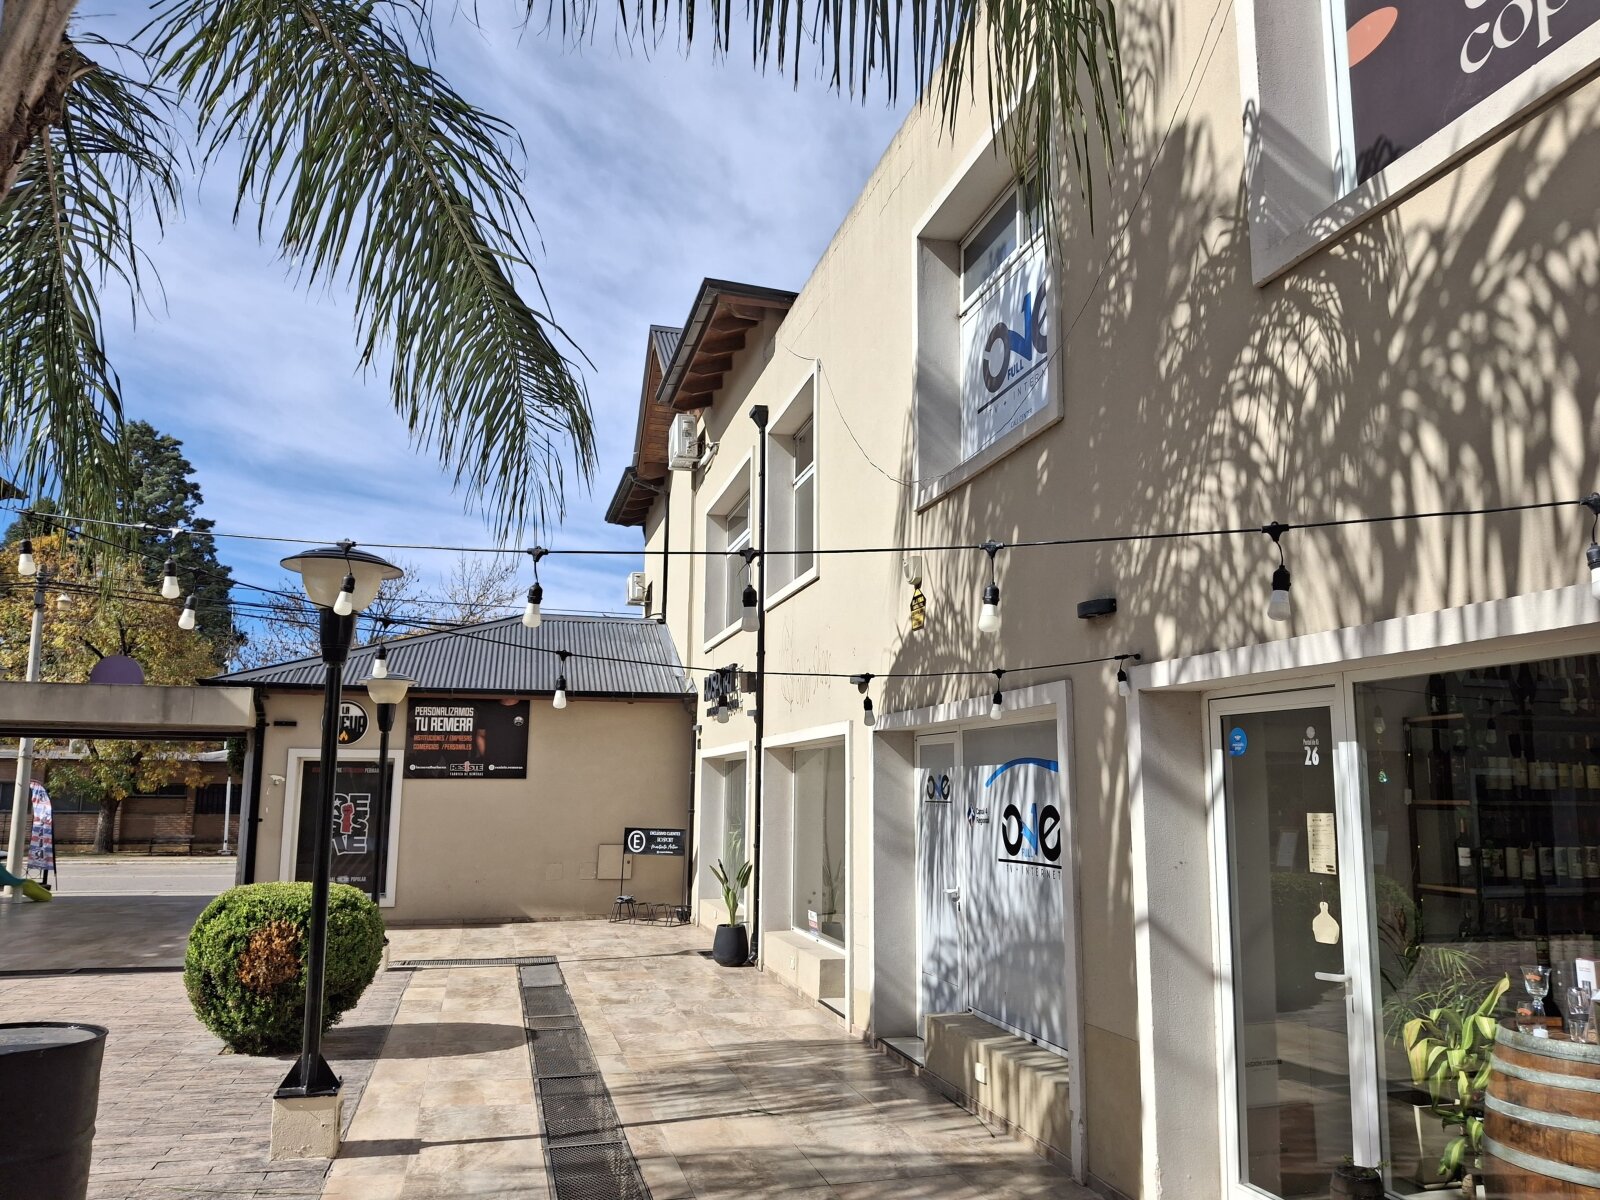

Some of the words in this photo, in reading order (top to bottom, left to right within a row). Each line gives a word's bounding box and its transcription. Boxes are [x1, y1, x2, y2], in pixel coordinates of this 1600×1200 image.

[1007, 360, 1024, 381] FULL
[341, 705, 350, 714] LA
[415, 706, 474, 717] PERSONALIZAMOS
[415, 717, 428, 731] TU
[430, 717, 473, 732] REMERA
[1304, 746, 1320, 765] 26
